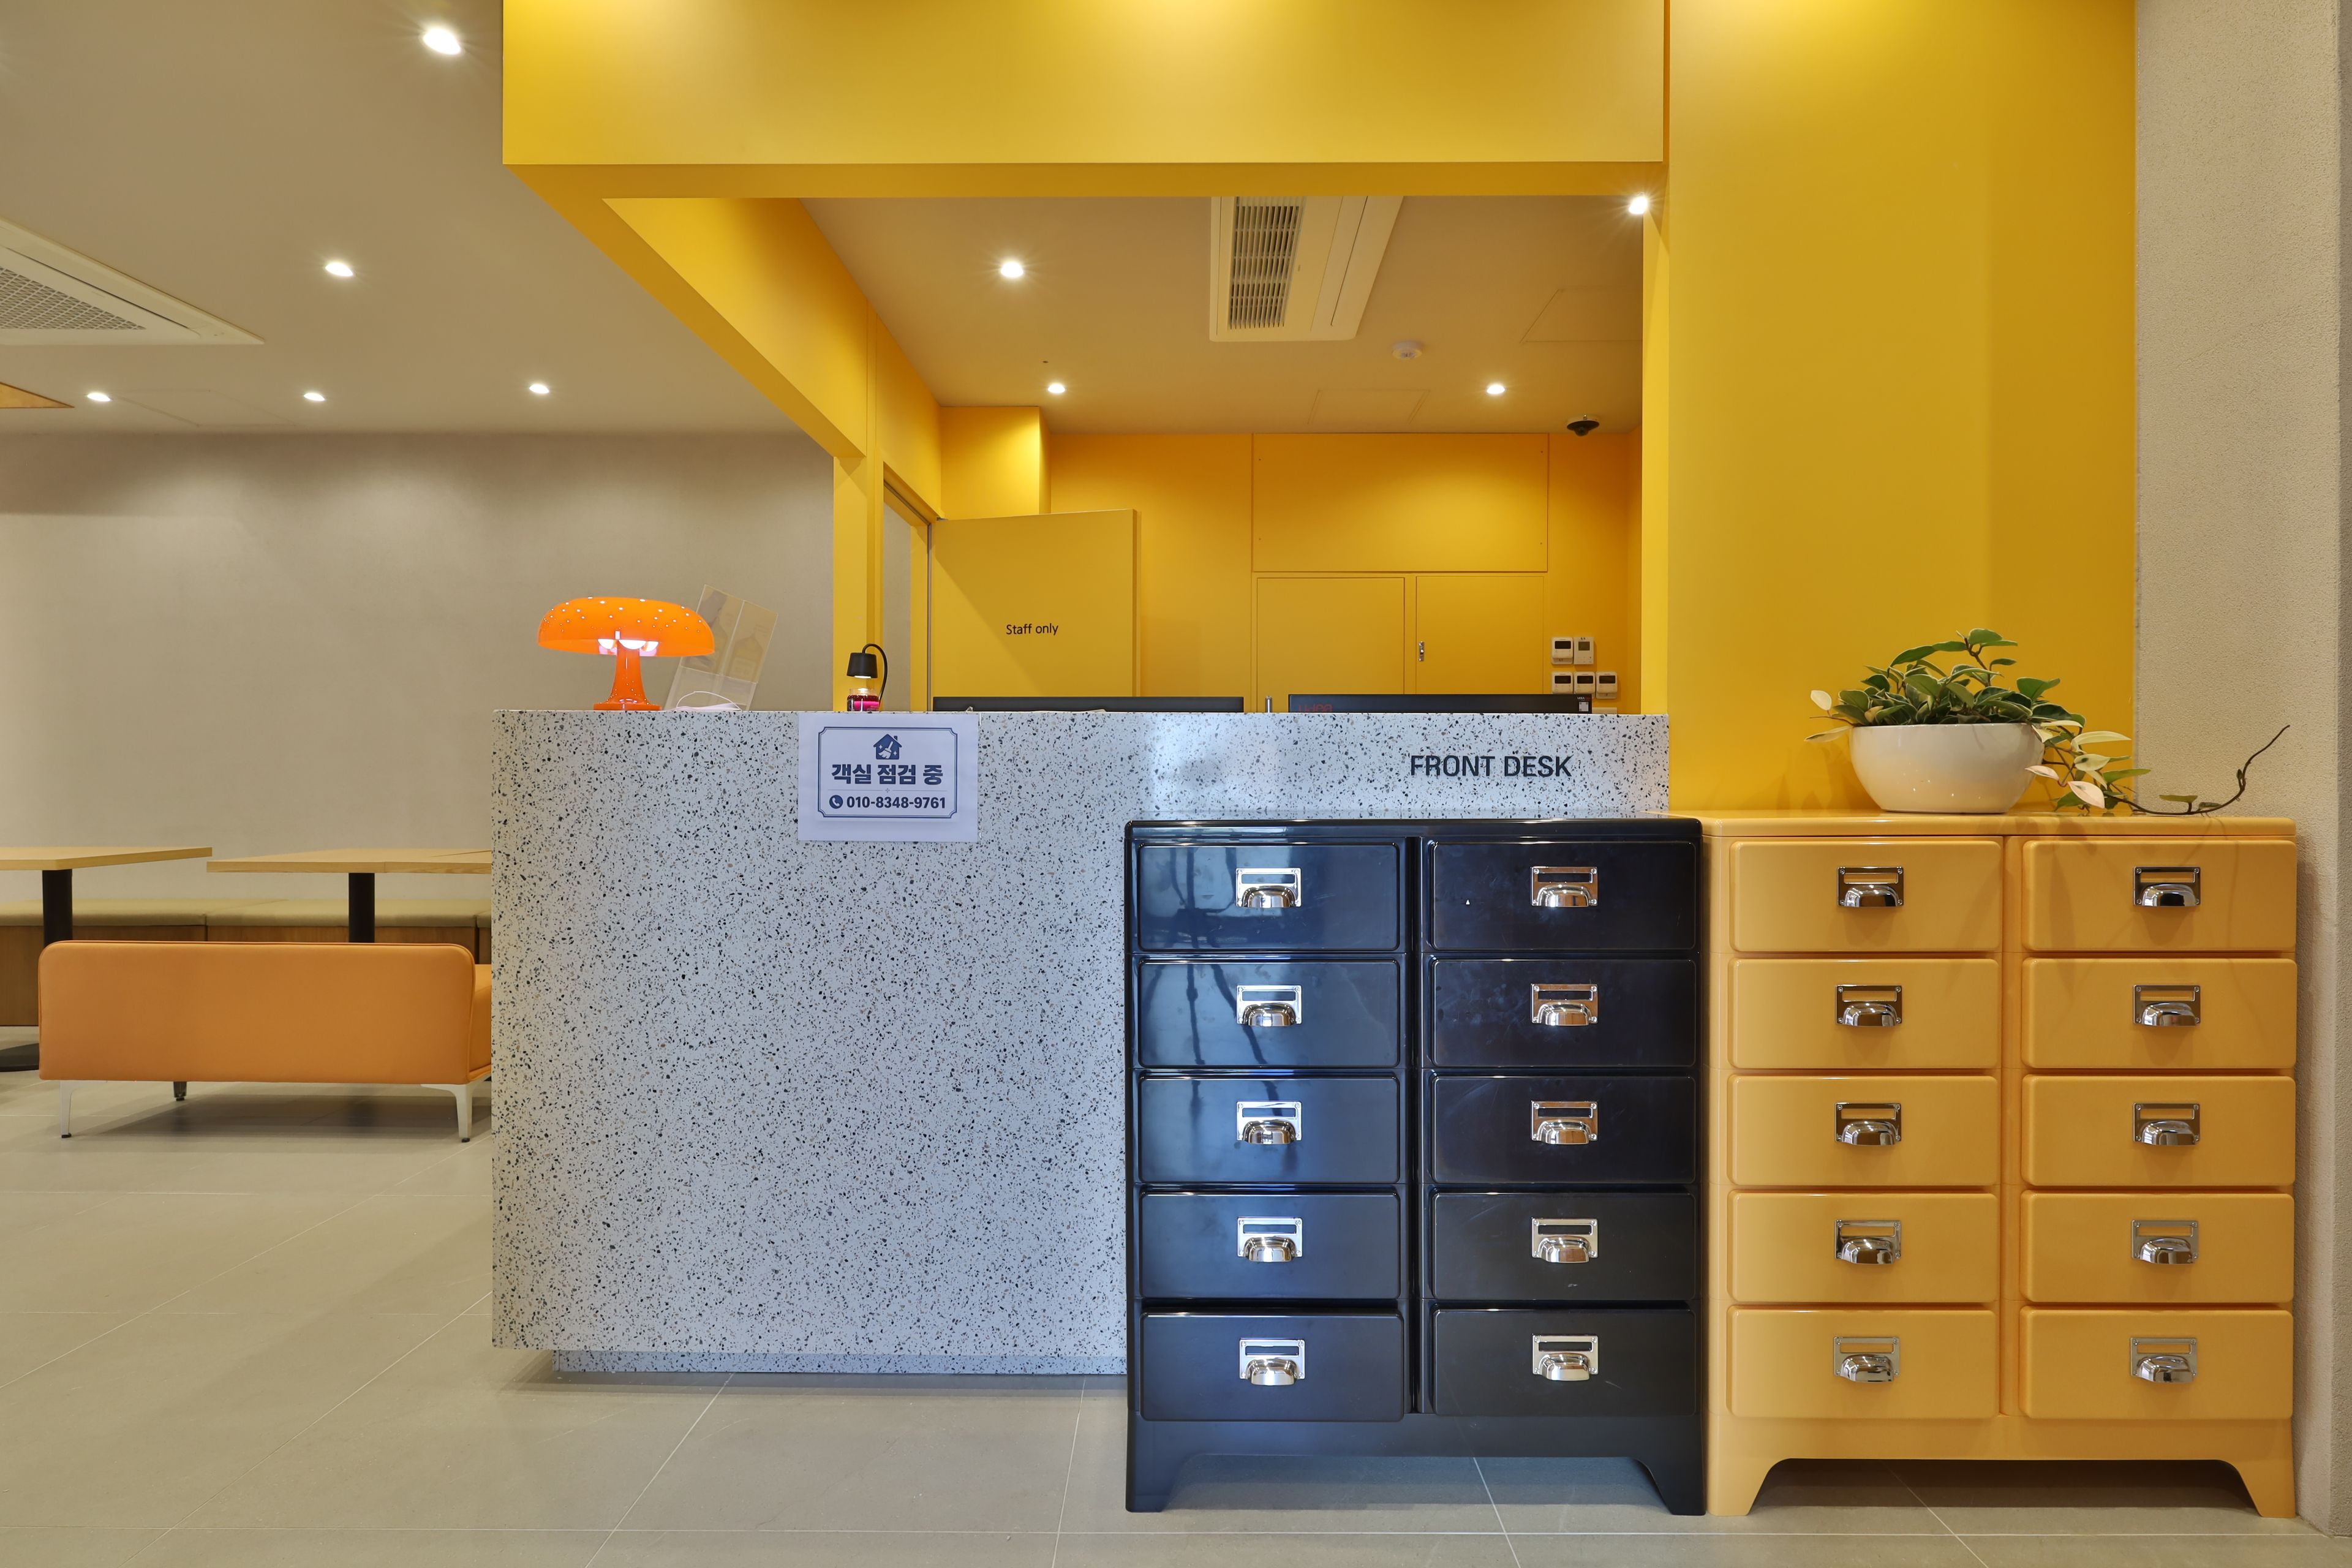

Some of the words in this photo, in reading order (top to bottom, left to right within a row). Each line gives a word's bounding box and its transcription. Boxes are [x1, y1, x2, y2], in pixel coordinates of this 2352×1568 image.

[1006, 624, 1033, 635] Staff
[1035, 622, 1059, 636] only
[831, 764, 872, 785] 객실
[877, 764, 916, 785] 점검
[922, 764, 943, 785] 중
[1411, 755, 1496, 777] FRONT
[1504, 755, 1574, 777] DESK
[846, 796, 946, 809] 010-8348-9761
